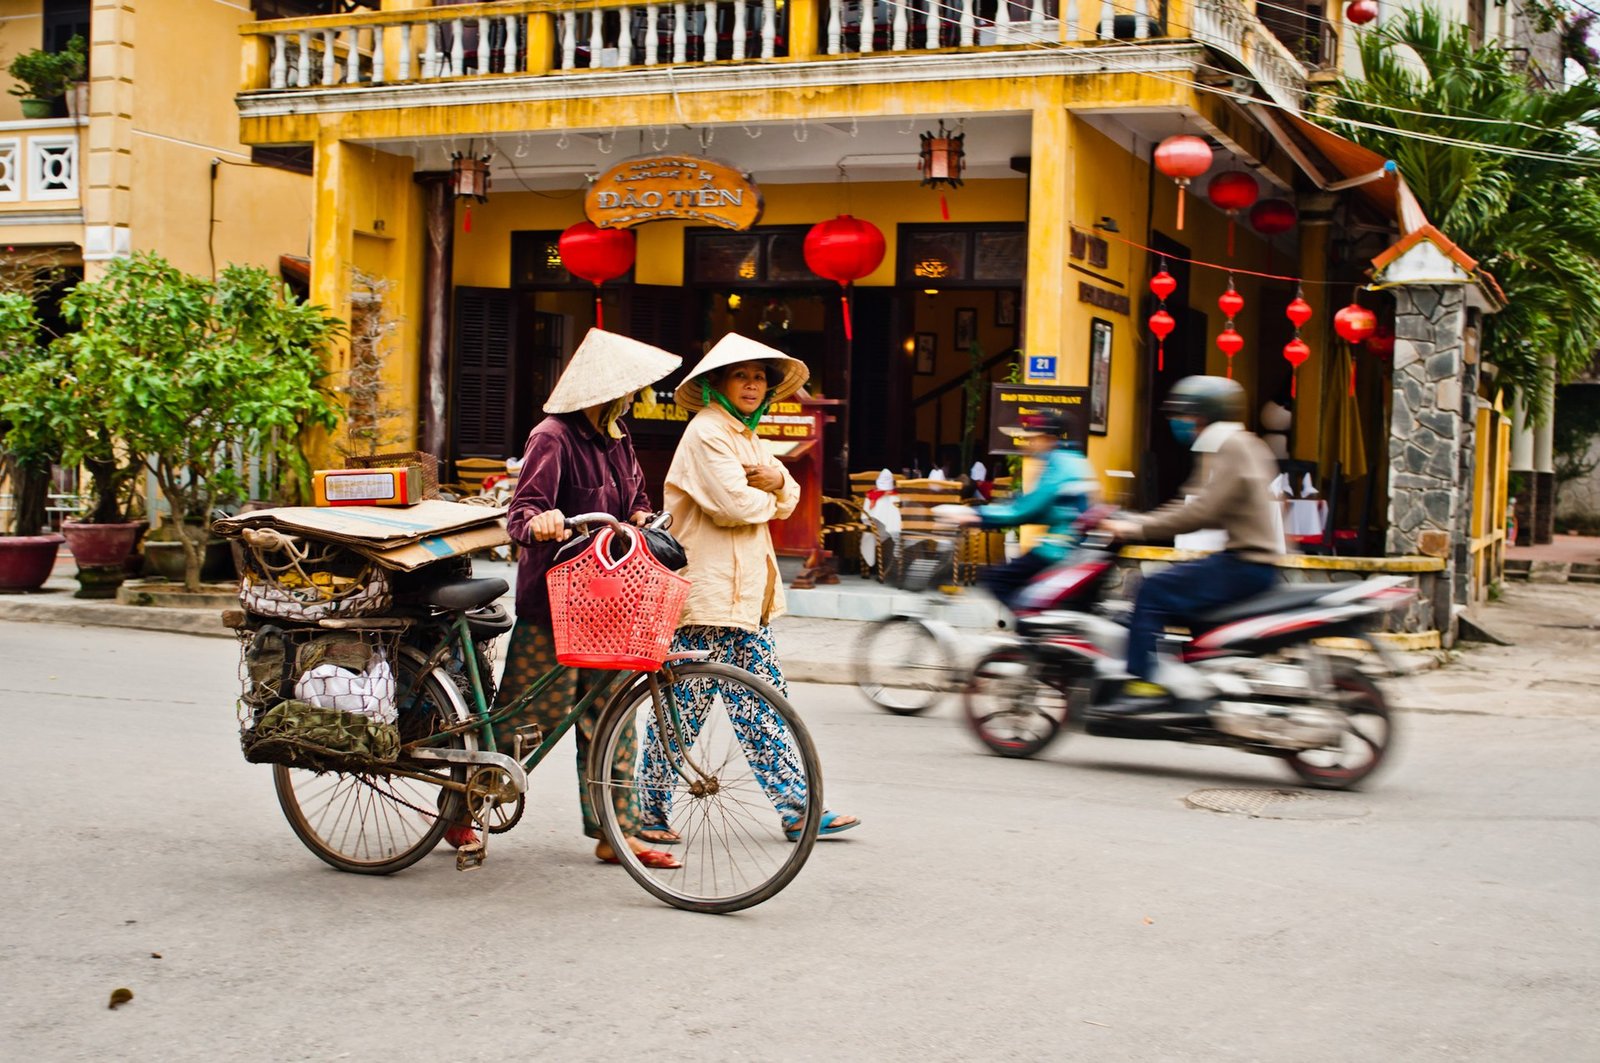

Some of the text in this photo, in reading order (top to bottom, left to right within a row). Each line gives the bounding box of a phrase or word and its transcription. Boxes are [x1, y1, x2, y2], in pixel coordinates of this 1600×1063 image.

[597, 183, 743, 209] ĐÀO TIÊN
[1037, 358, 1049, 369] 21
